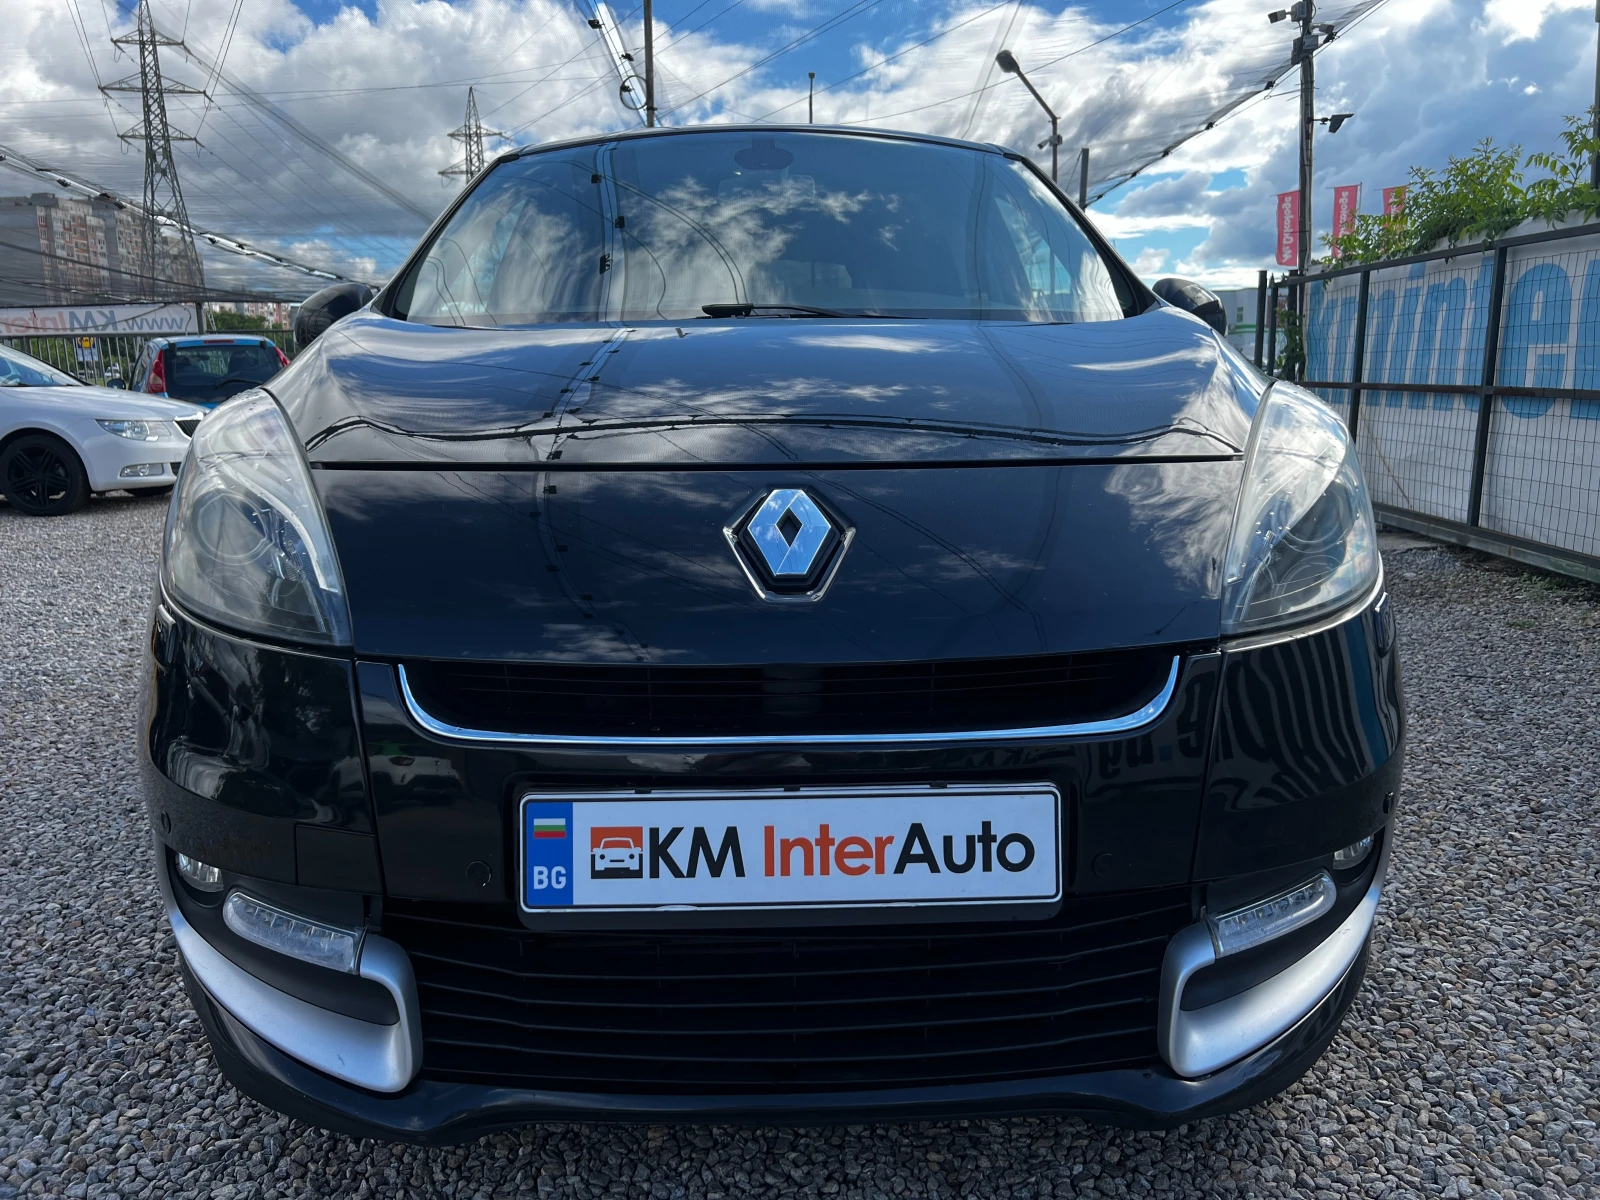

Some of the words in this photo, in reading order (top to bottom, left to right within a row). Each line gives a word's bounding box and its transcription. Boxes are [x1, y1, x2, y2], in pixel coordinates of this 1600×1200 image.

[649, 826, 746, 878] KM
[764, 820, 1035, 877] InterAuto
[533, 865, 567, 889] BG
